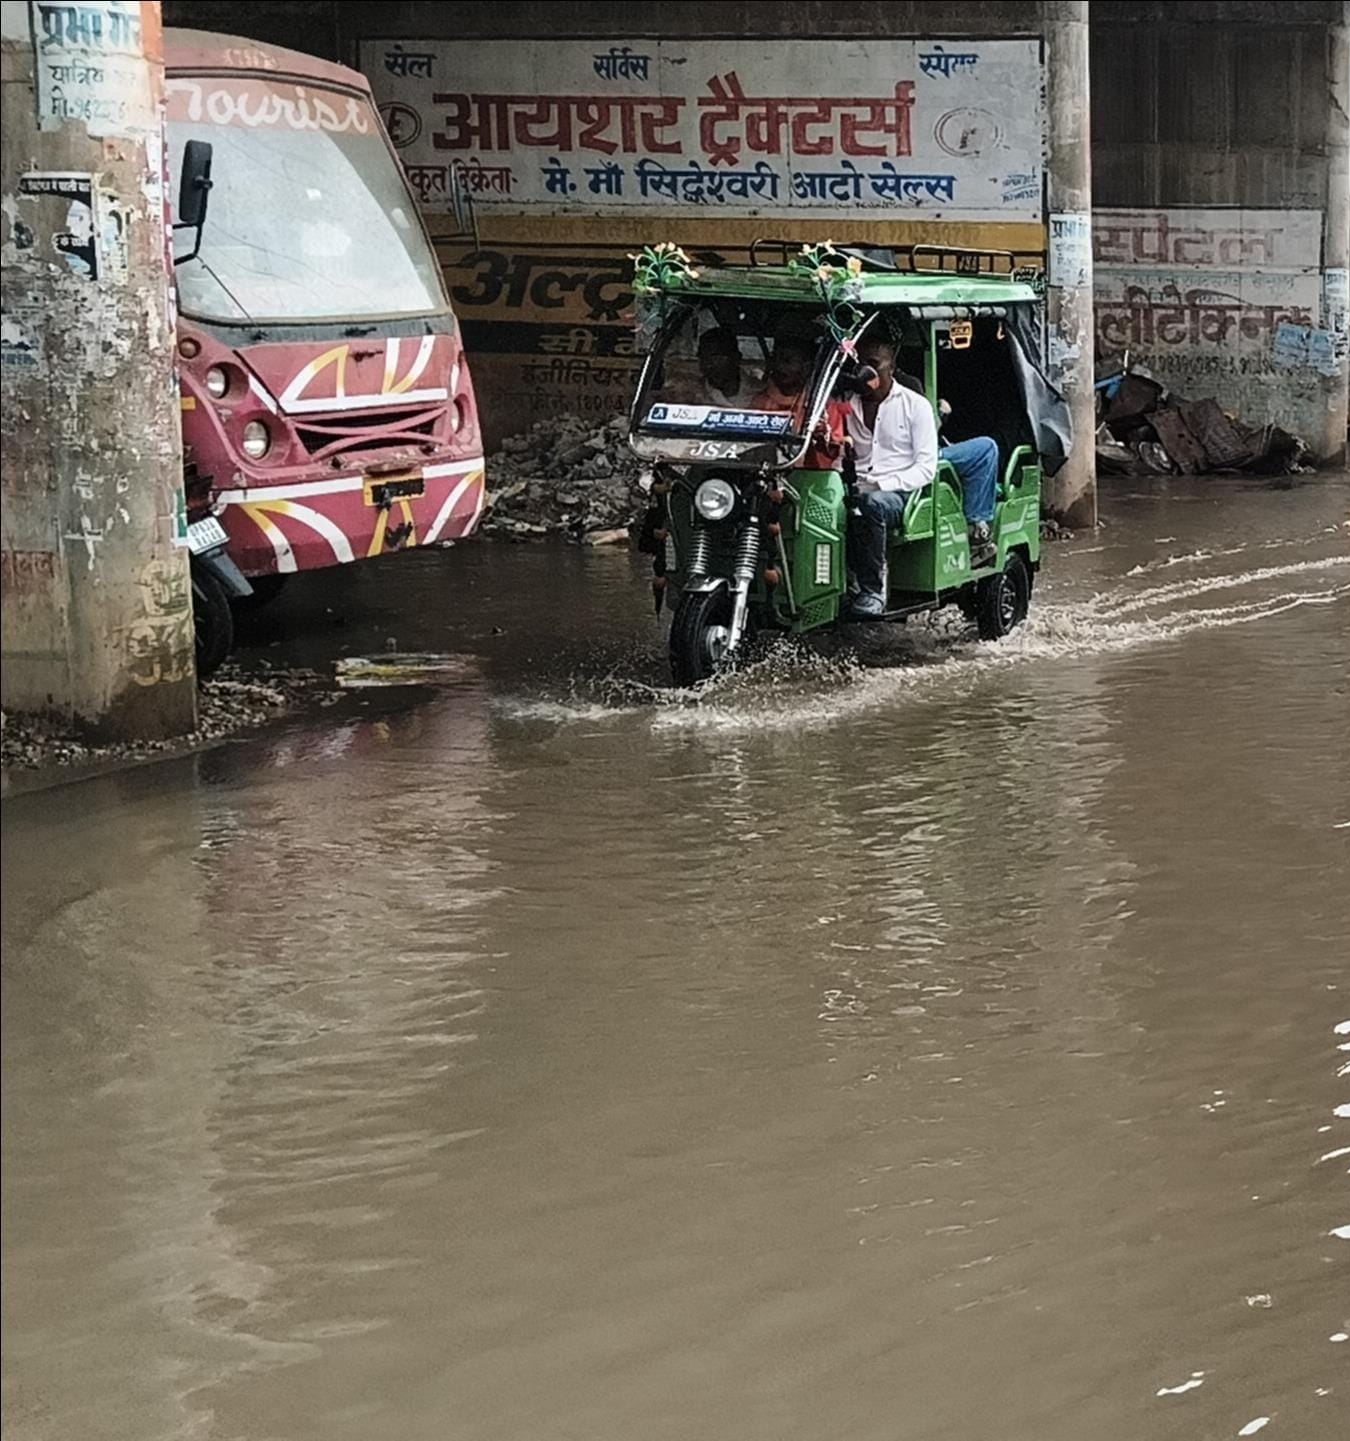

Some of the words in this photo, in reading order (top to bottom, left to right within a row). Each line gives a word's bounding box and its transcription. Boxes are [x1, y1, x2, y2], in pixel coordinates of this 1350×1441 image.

[383, 45, 436, 79] सेल
[593, 47, 652, 81] सर्विस
[168, 76, 369, 134] Tourist
[431, 93, 687, 155] आयशर
[697, 70, 916, 168] ट्रैक्टर्स
[400, 157, 447, 198] कृत
[792, 160, 864, 201] आटो
[868, 161, 957, 203] सेल्स
[689, 440, 740, 461] JSA
